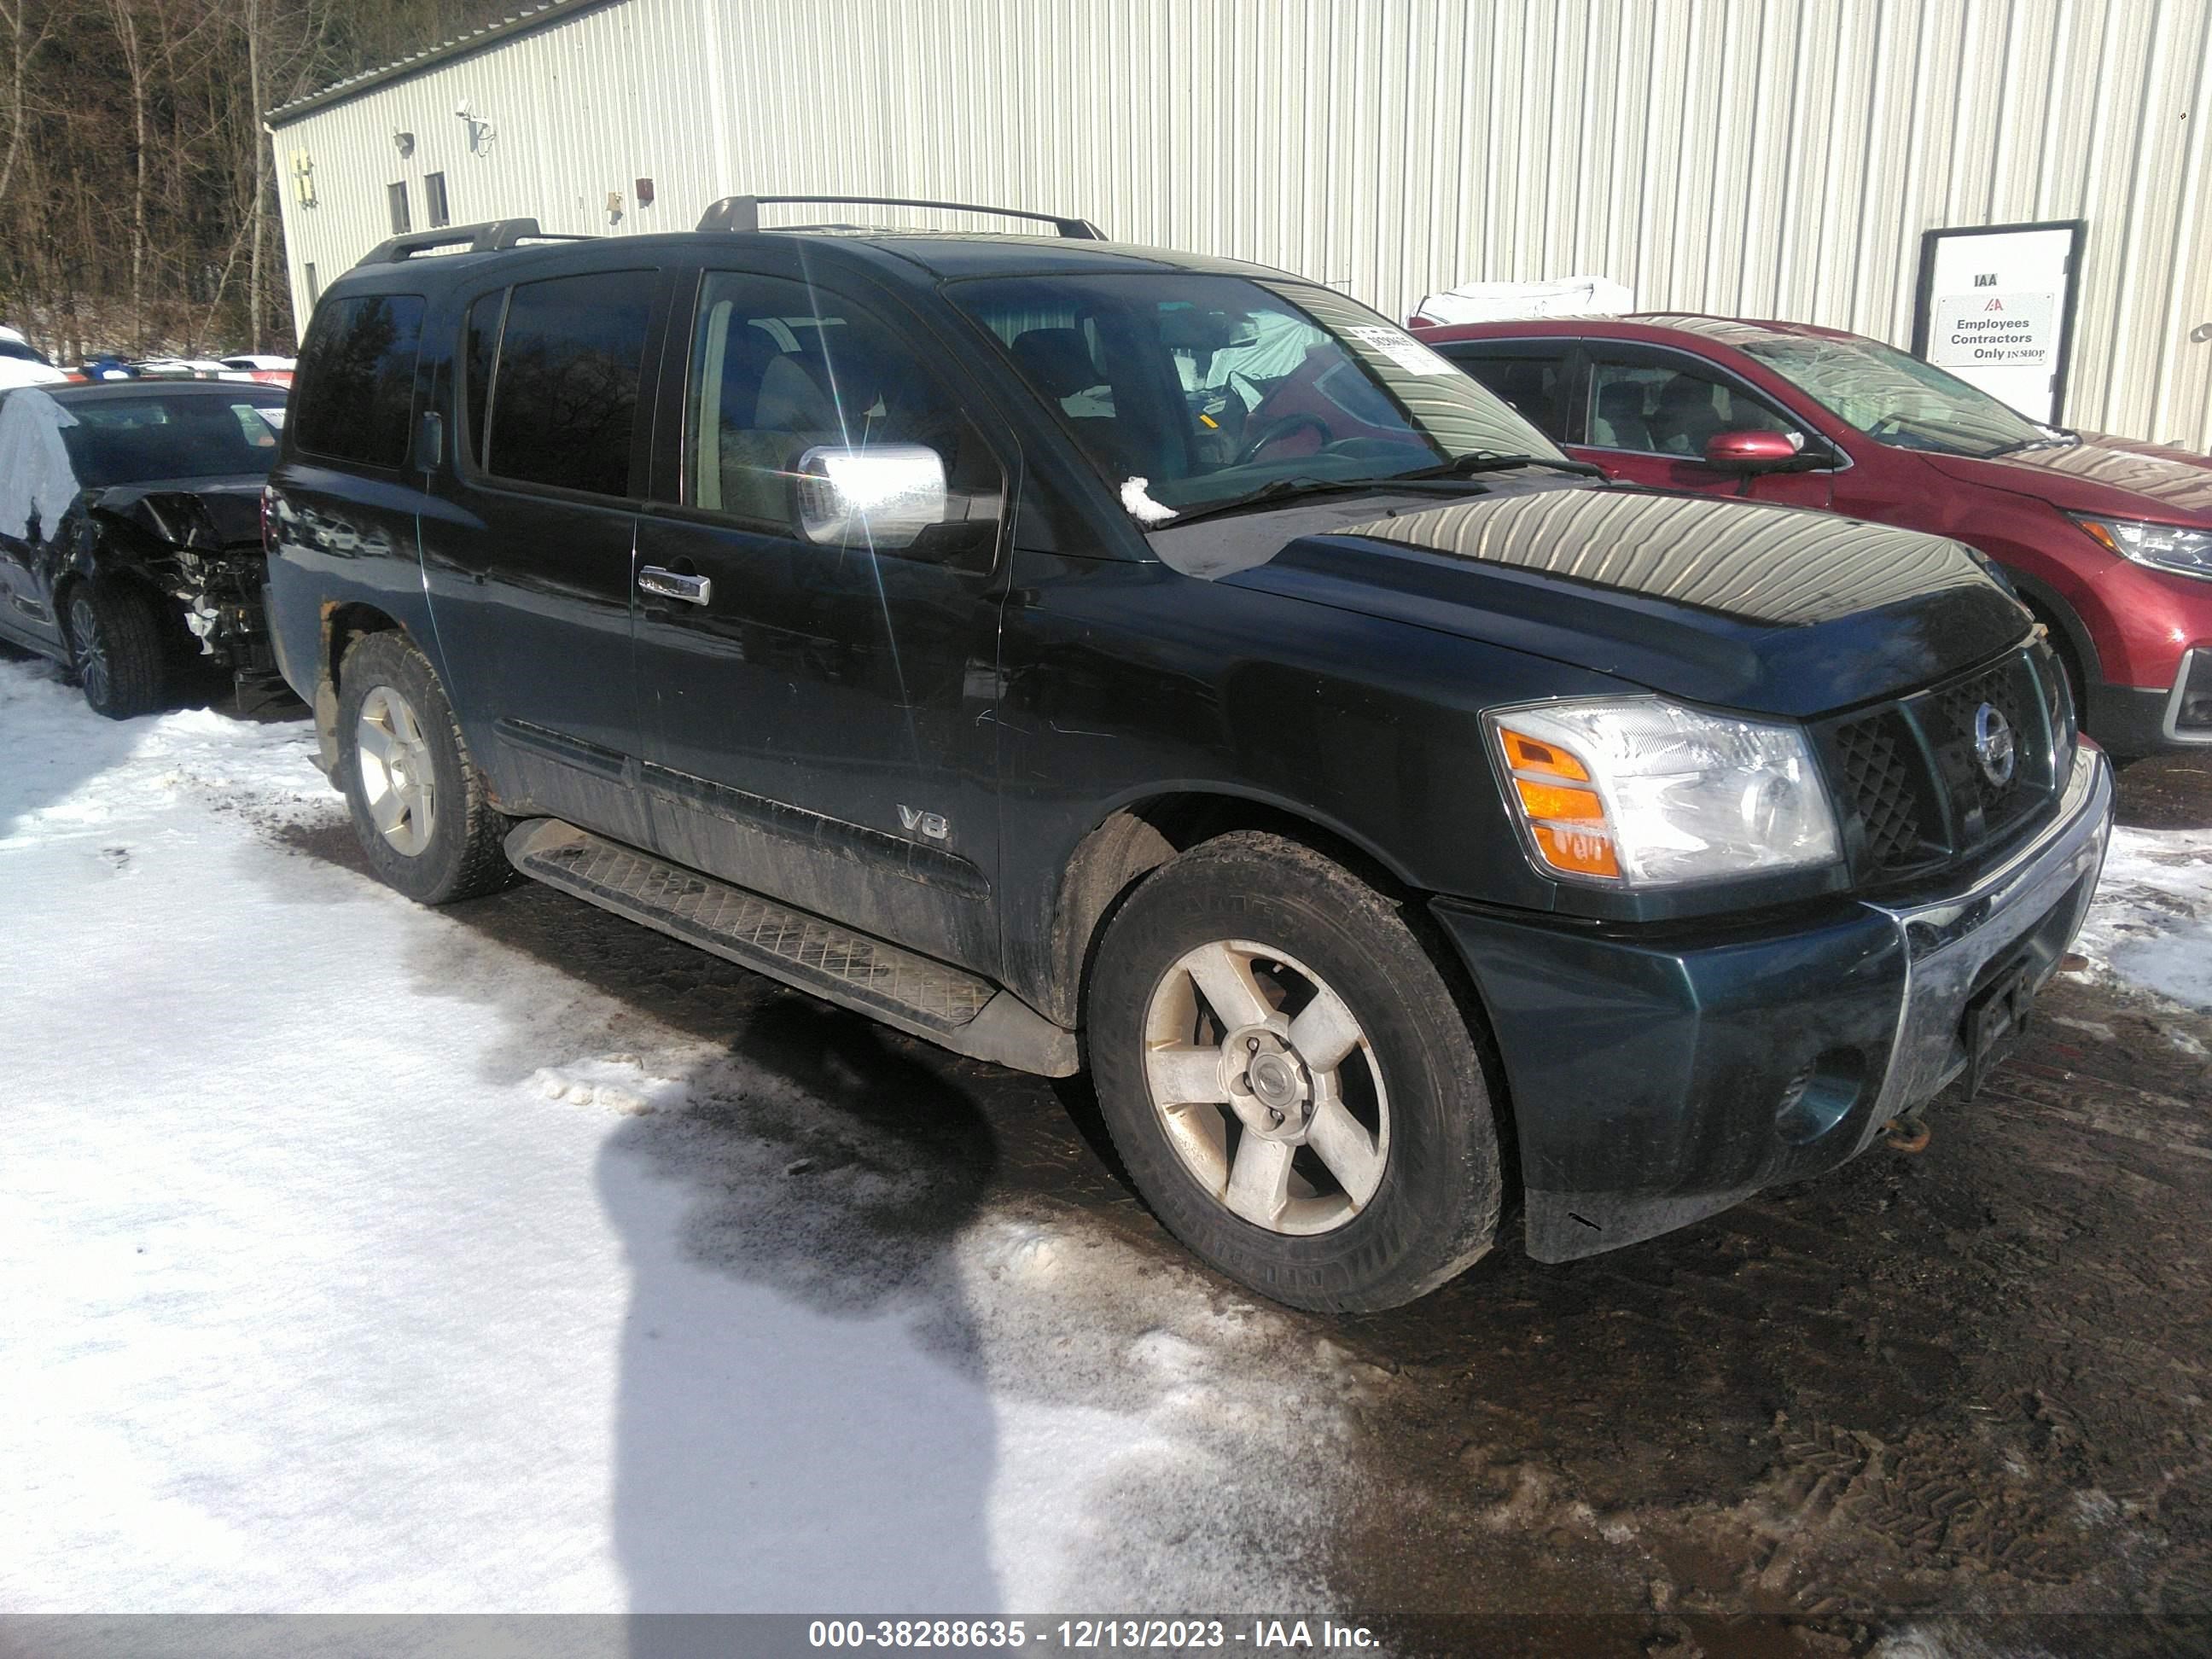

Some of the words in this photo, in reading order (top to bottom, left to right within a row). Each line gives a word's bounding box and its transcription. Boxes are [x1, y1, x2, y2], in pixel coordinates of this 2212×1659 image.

[1974, 273, 1998, 288] IAA
[1957, 318, 2030, 331] Employees
[1951, 334, 2033, 345] Contractors
[1974, 348, 2005, 361] Only
[896, 803, 949, 840] V8
